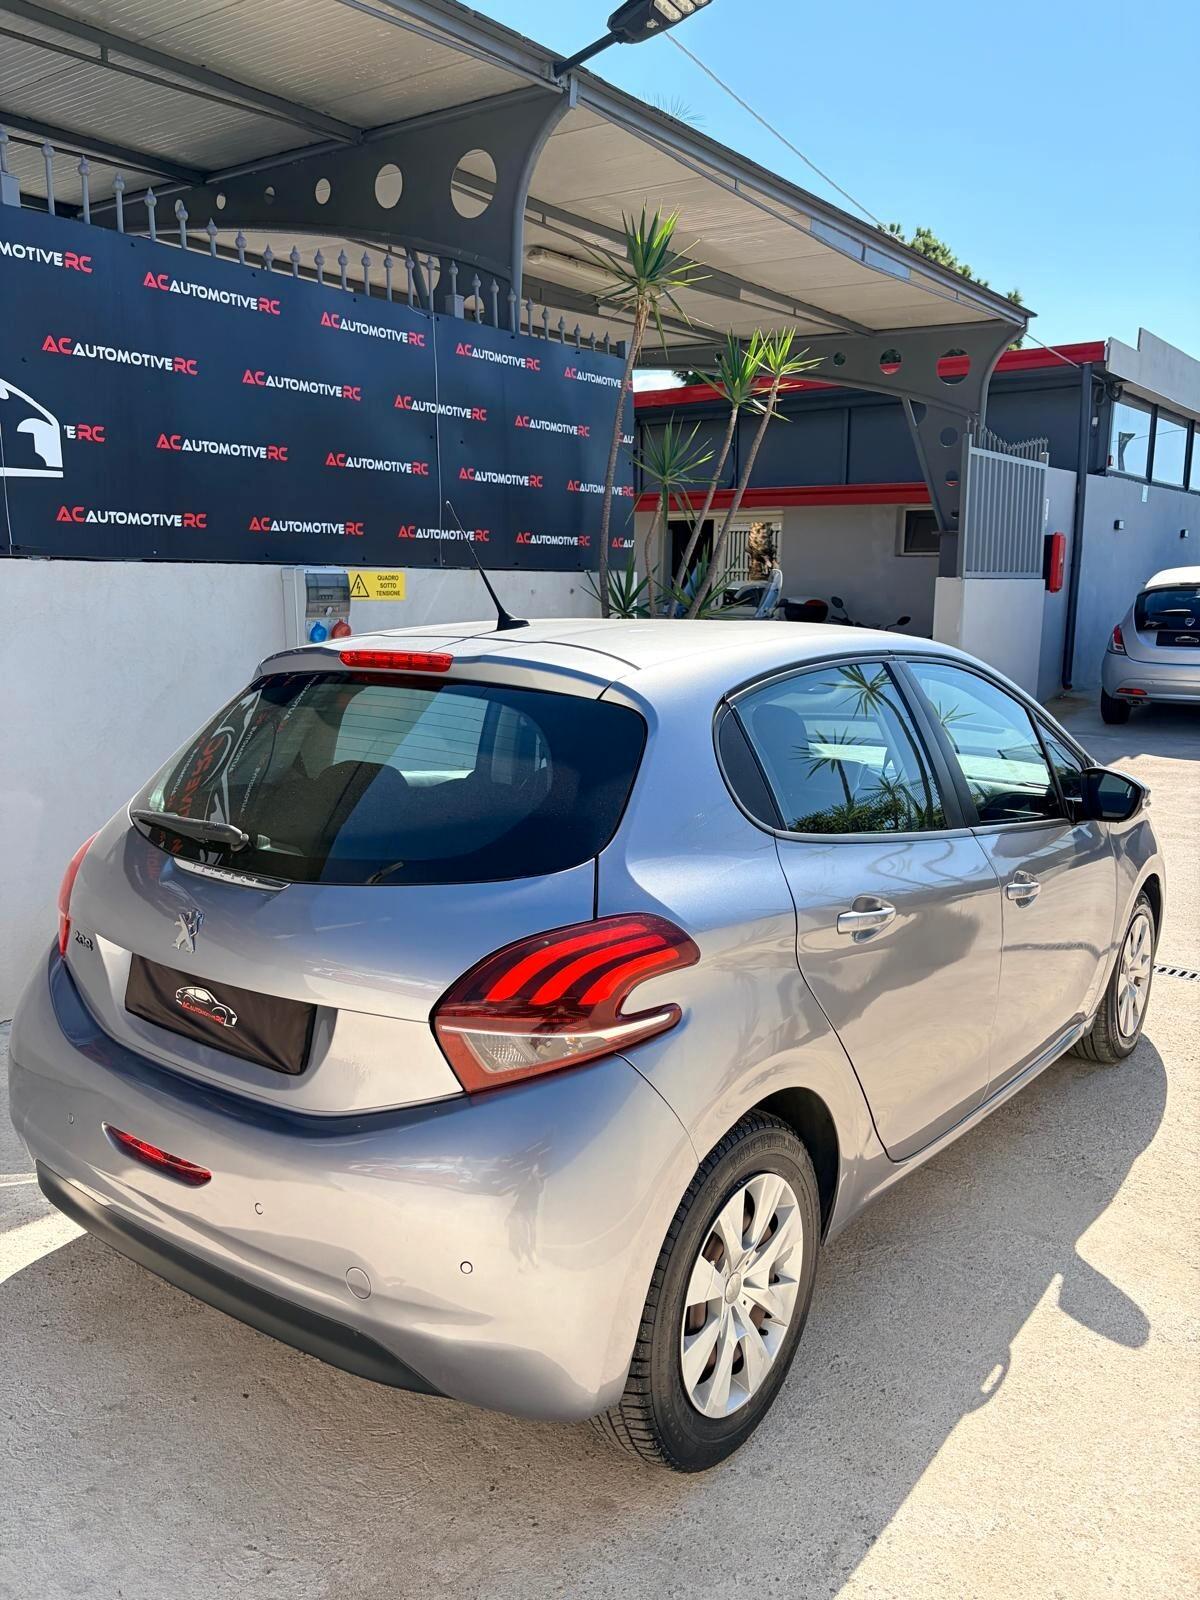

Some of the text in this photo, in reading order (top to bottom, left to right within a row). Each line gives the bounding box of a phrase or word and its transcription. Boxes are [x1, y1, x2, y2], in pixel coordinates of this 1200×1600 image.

[564, 366, 633, 391] ACAUTOMOTIVEC
[63, 424, 106, 443] ERC
[567, 479, 634, 497] ACAUTOMIVERC
